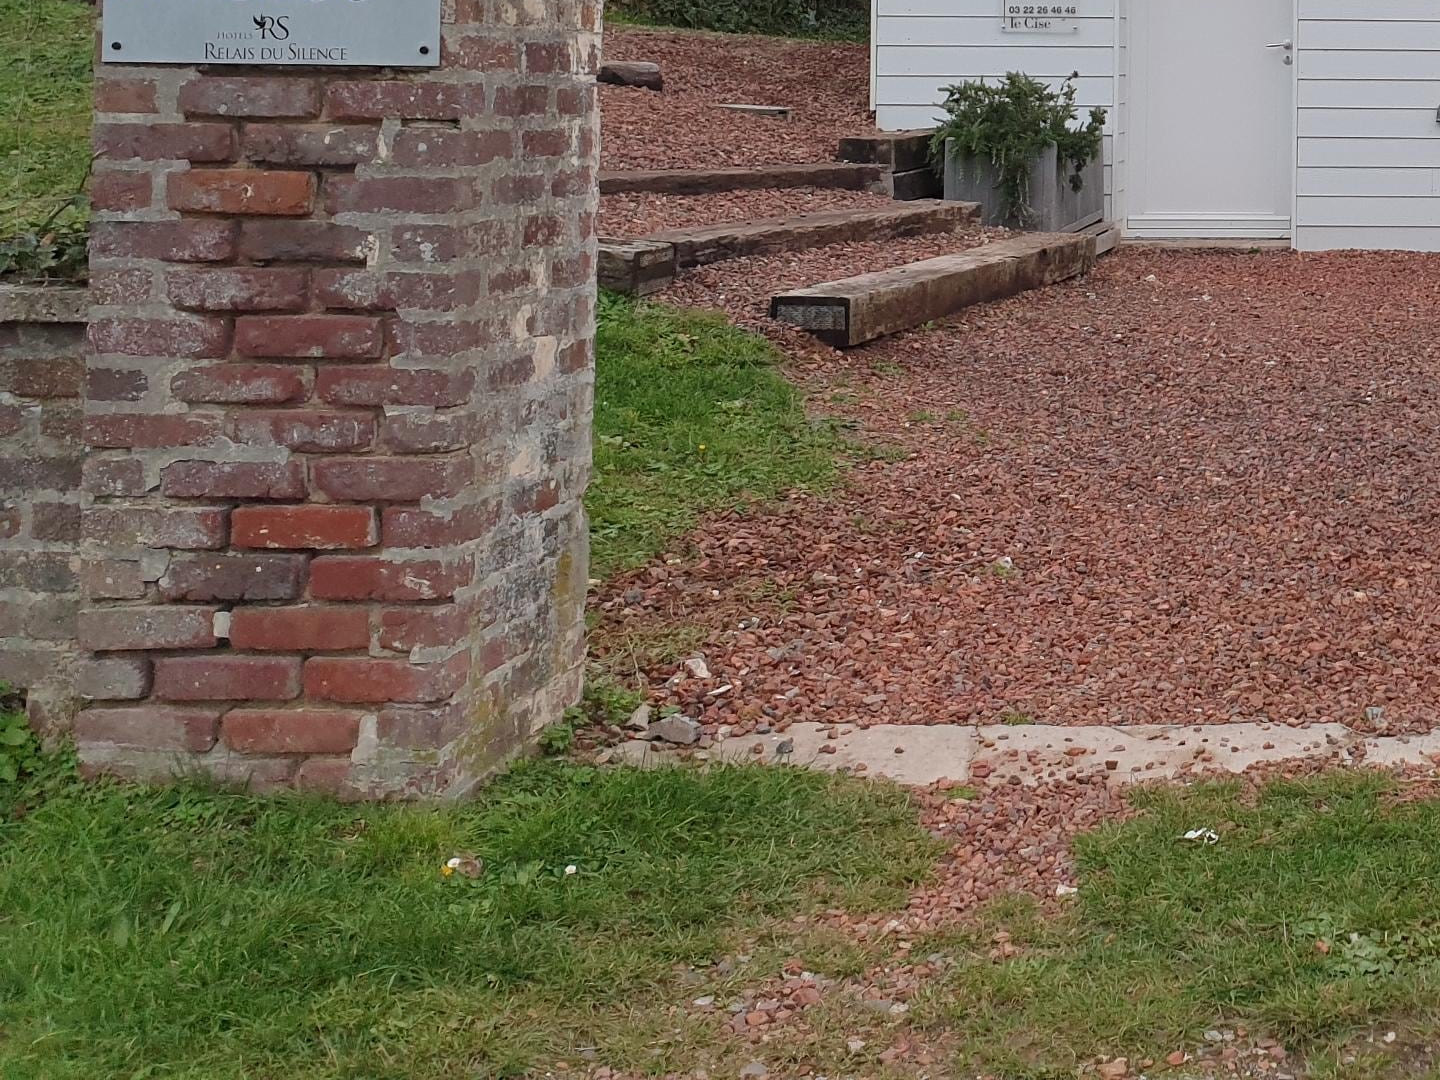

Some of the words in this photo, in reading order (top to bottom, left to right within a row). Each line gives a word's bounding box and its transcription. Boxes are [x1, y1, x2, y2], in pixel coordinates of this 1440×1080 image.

[1008, 6, 1020, 14] 03
[1023, 6, 1034, 14] 22
[1037, 6, 1048, 14] 26
[1024, 16, 1051, 29] Cise
